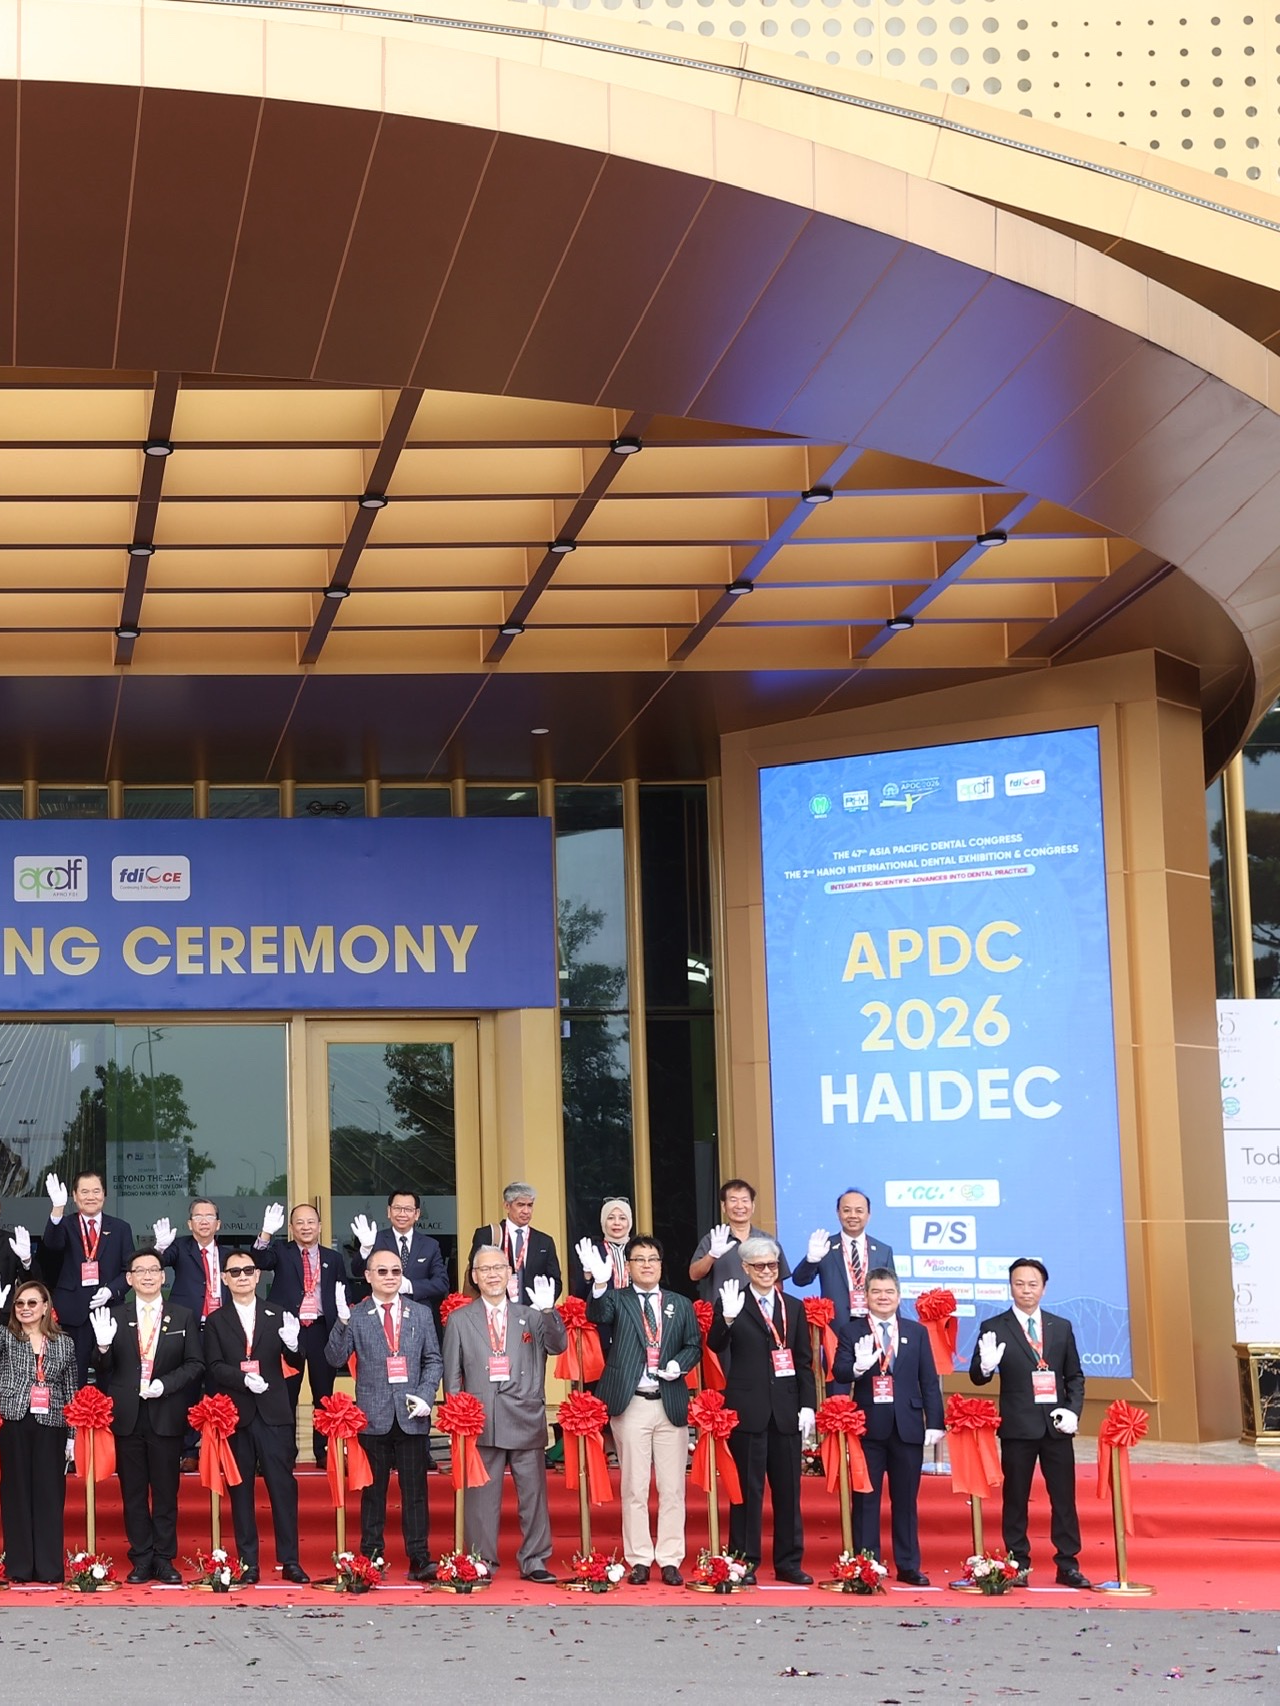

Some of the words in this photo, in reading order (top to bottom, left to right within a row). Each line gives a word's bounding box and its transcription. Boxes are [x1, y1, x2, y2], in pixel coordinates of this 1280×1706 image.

[833, 850, 850, 860] THE
[869, 846, 891, 857] ASIA
[893, 843, 929, 855] PACIFIC
[930, 839, 967, 851] DENTAL
[969, 833, 1023, 847] CONGRESS
[120, 868, 144, 883] fdi
[784, 870, 801, 880] THE
[816, 866, 846, 877] HANOI
[848, 859, 919, 874] INTERNATIONAL
[921, 856, 956, 868] DENTAL
[958, 850, 1012, 864] EXHIBITION
[1014, 849, 1021, 859] &
[1023, 844, 1080, 858] CONGRESS
[830, 881, 874, 891] INTEGRATING
[875, 877, 911, 887] SCIENTIFIC
[912, 874, 948, 884] ADVANCES
[967, 870, 993, 879] DENTAL
[994, 867, 1028, 876] PRACTICE
[122, 924, 479, 976] CEREMONY
[841, 920, 1023, 983] APDC
[860, 995, 1011, 1052] 2026
[820, 1065, 1063, 1125] HAIDEC
[112, 1174, 146, 1183] BEYOND
[147, 1174, 163, 1182] THE
[1242, 1176, 1257, 1184] 105
[923, 1221, 967, 1244] P/S
